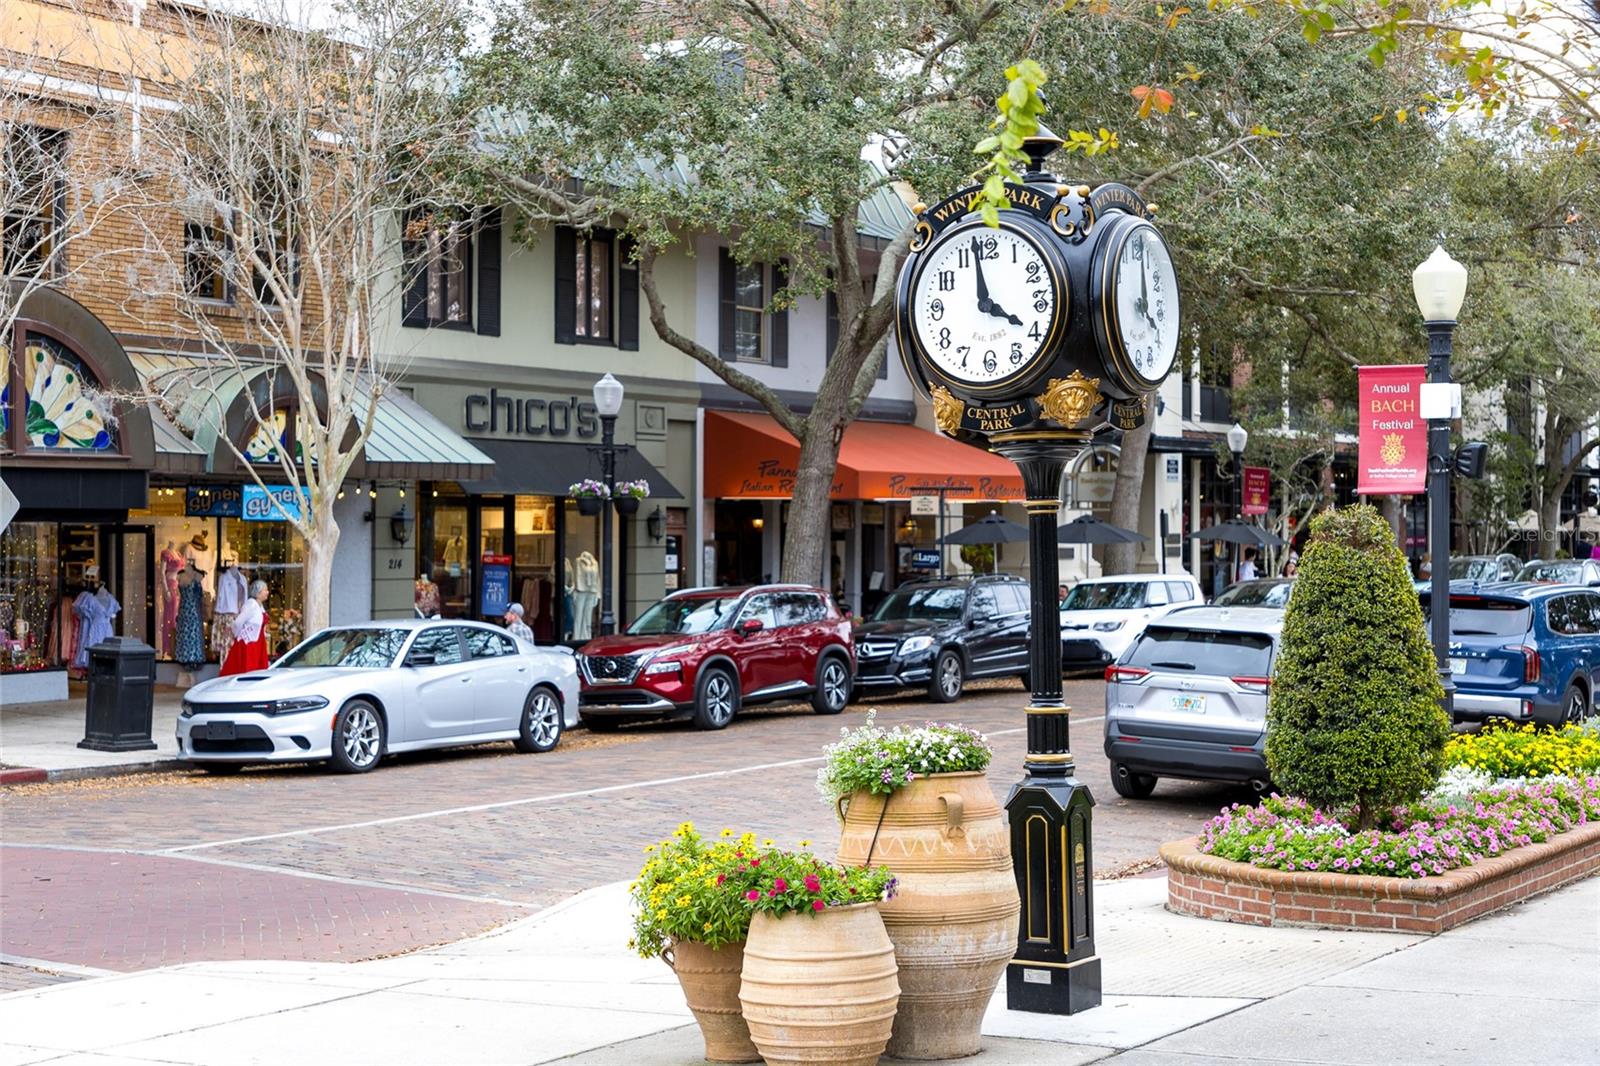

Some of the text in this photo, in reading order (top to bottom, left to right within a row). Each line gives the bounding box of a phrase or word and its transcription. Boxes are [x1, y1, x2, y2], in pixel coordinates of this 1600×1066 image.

[1003, 187, 1044, 210] PARK
[958, 248, 969, 268] 11
[979, 237, 999, 260] 12
[938, 270, 955, 291] 10
[1025, 261, 1041, 284] 2
[930, 298, 944, 321] 9
[1032, 289, 1049, 313] 3
[939, 327, 951, 349] 8
[1027, 320, 1042, 341] 4
[956, 345, 971, 367] 7
[983, 350, 997, 373] 6
[1009, 342, 1023, 364] 5
[1372, 383, 1410, 393] Annual
[967, 404, 1026, 420] CENTRAL
[1113, 405, 1142, 419] CENTRAL
[1371, 399, 1415, 413] BACH
[981, 418, 1013, 430] PARK
[1119, 417, 1137, 429] PARK
[1372, 419, 1414, 430] Festival
[978, 476, 1025, 497] Restauran
[389, 559, 402, 569] 214
